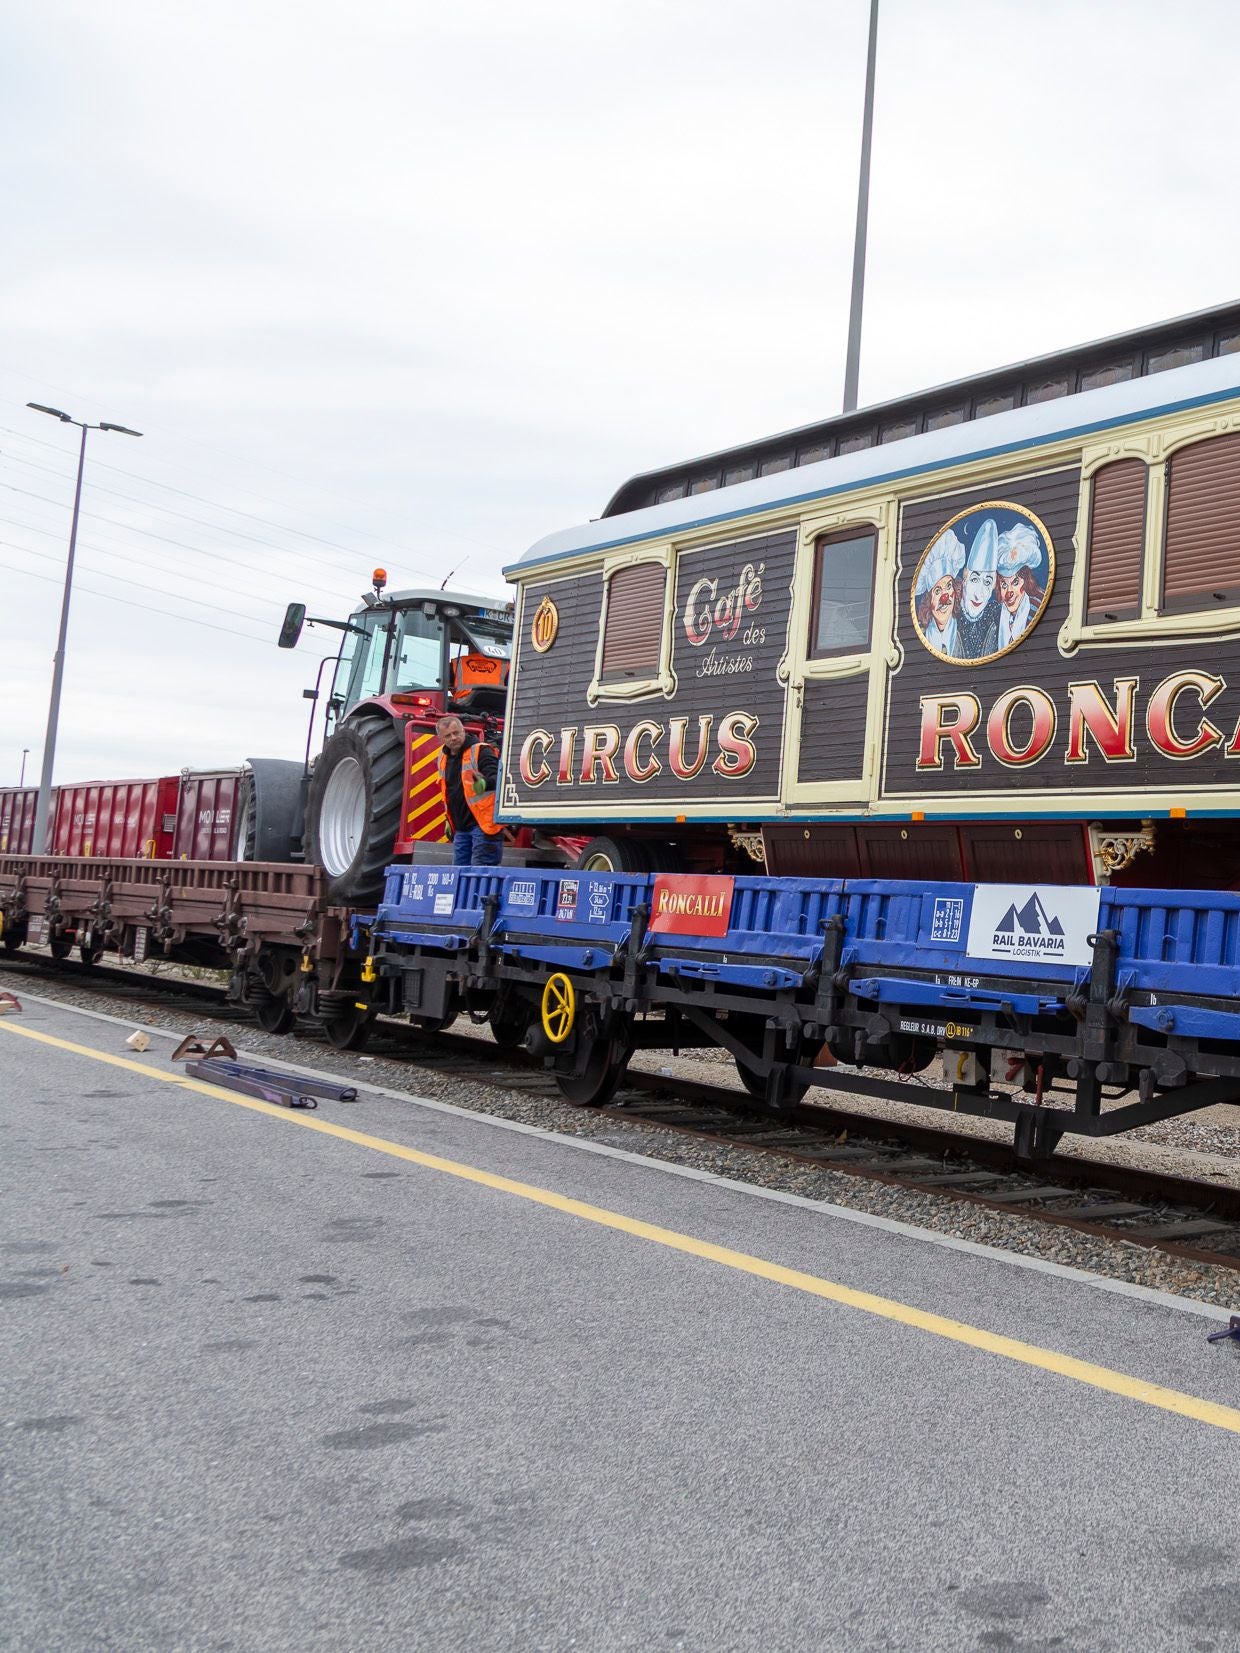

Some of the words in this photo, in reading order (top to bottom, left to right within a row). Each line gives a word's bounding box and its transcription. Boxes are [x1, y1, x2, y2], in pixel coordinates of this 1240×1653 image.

[683, 562, 766, 646] Café
[538, 613, 552, 641] 10
[743, 621, 767, 645] des
[696, 647, 753, 678] Artistes
[519, 710, 759, 788] CIRCUS
[658, 888, 726, 917] RONCALLI
[992, 934, 1015, 946] RAIL
[1018, 936, 1065, 950] BAVARIA
[1012, 948, 1041, 957] LOGISTIK
[900, 1020, 919, 1033] REGLEUR
